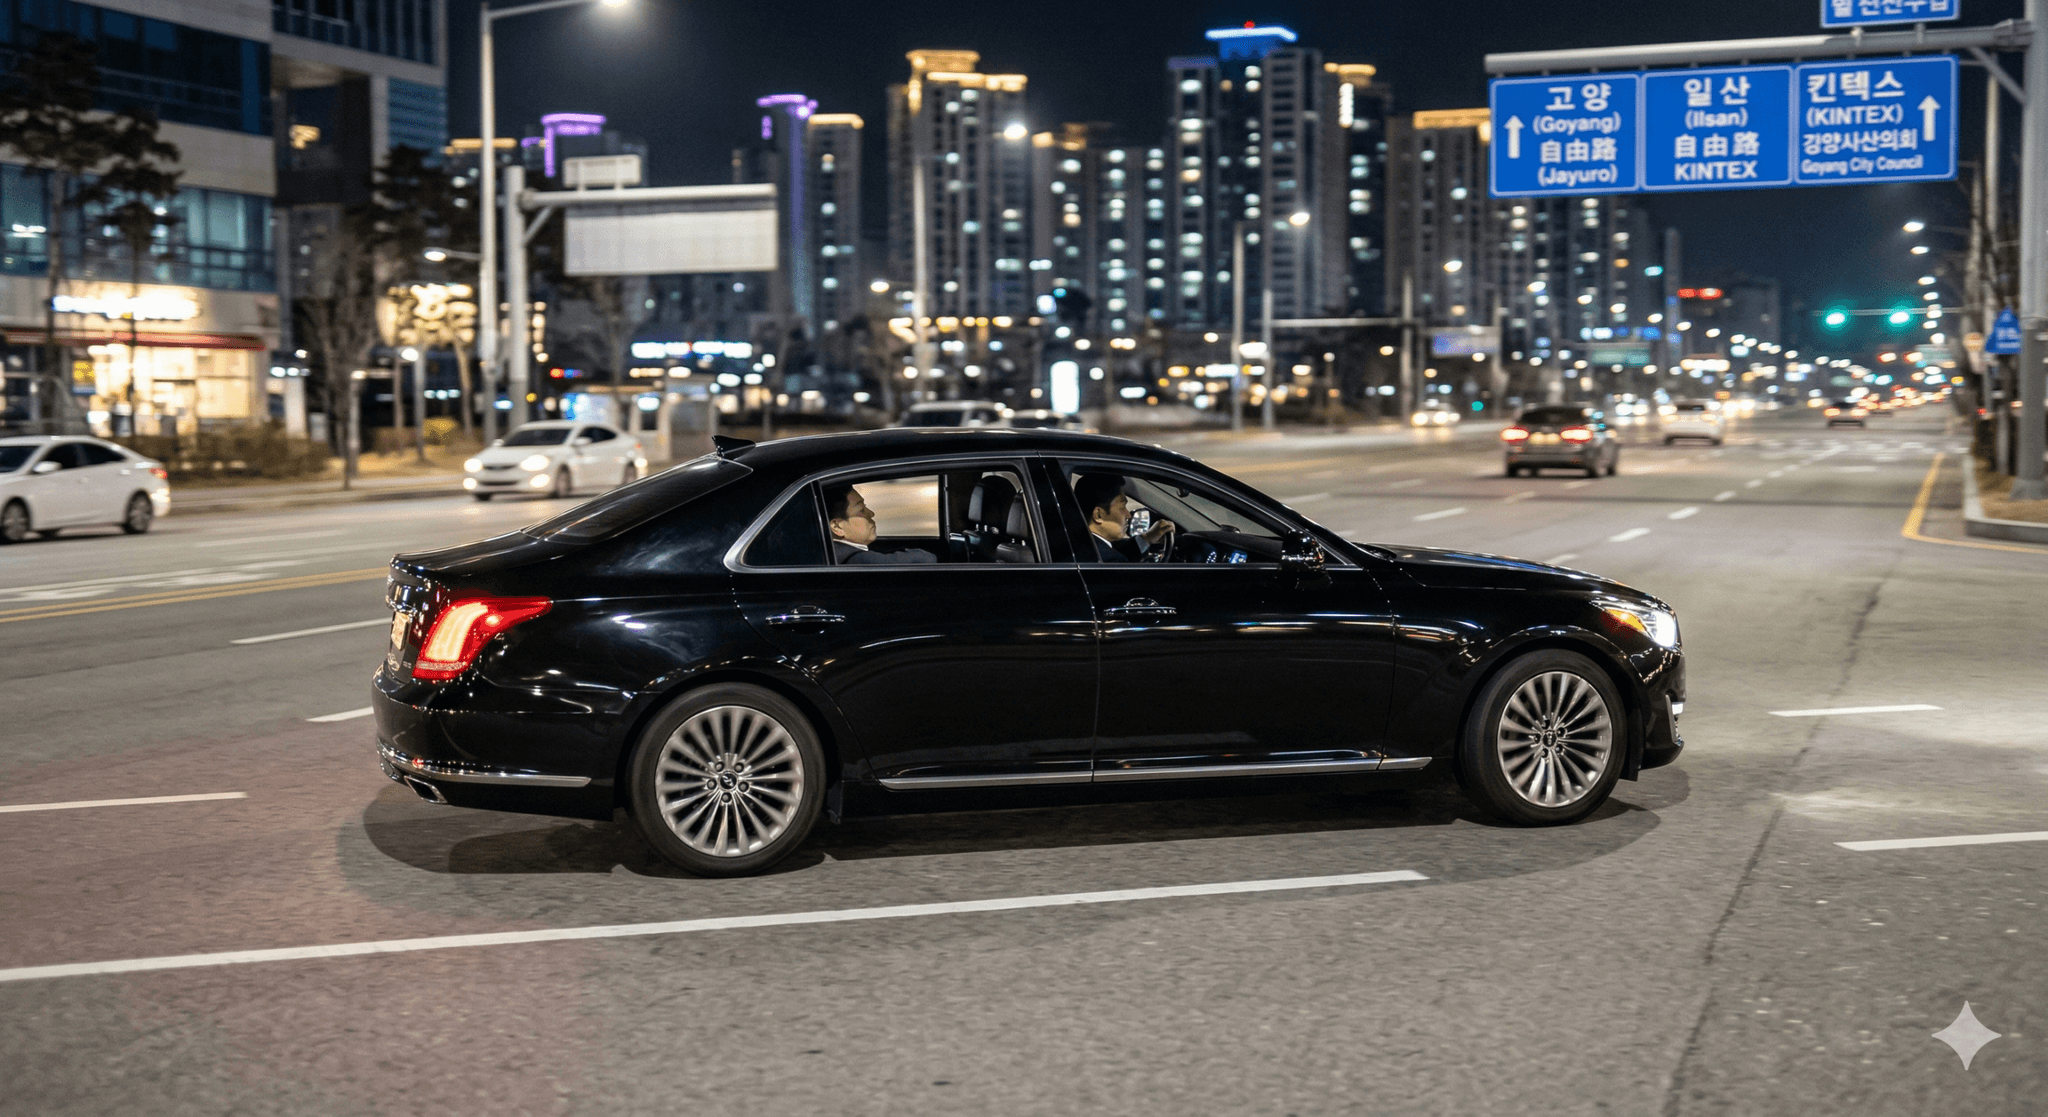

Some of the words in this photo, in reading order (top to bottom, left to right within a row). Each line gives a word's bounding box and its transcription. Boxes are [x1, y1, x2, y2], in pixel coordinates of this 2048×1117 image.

[1807, 70, 1905, 103] 킨텍스
[1532, 111, 1621, 135] (Goyang)
[1806, 103, 1903, 128] (KINTEX)
[1537, 163, 1618, 187] (Jayuro)
[1674, 160, 1758, 181] KINTEX
